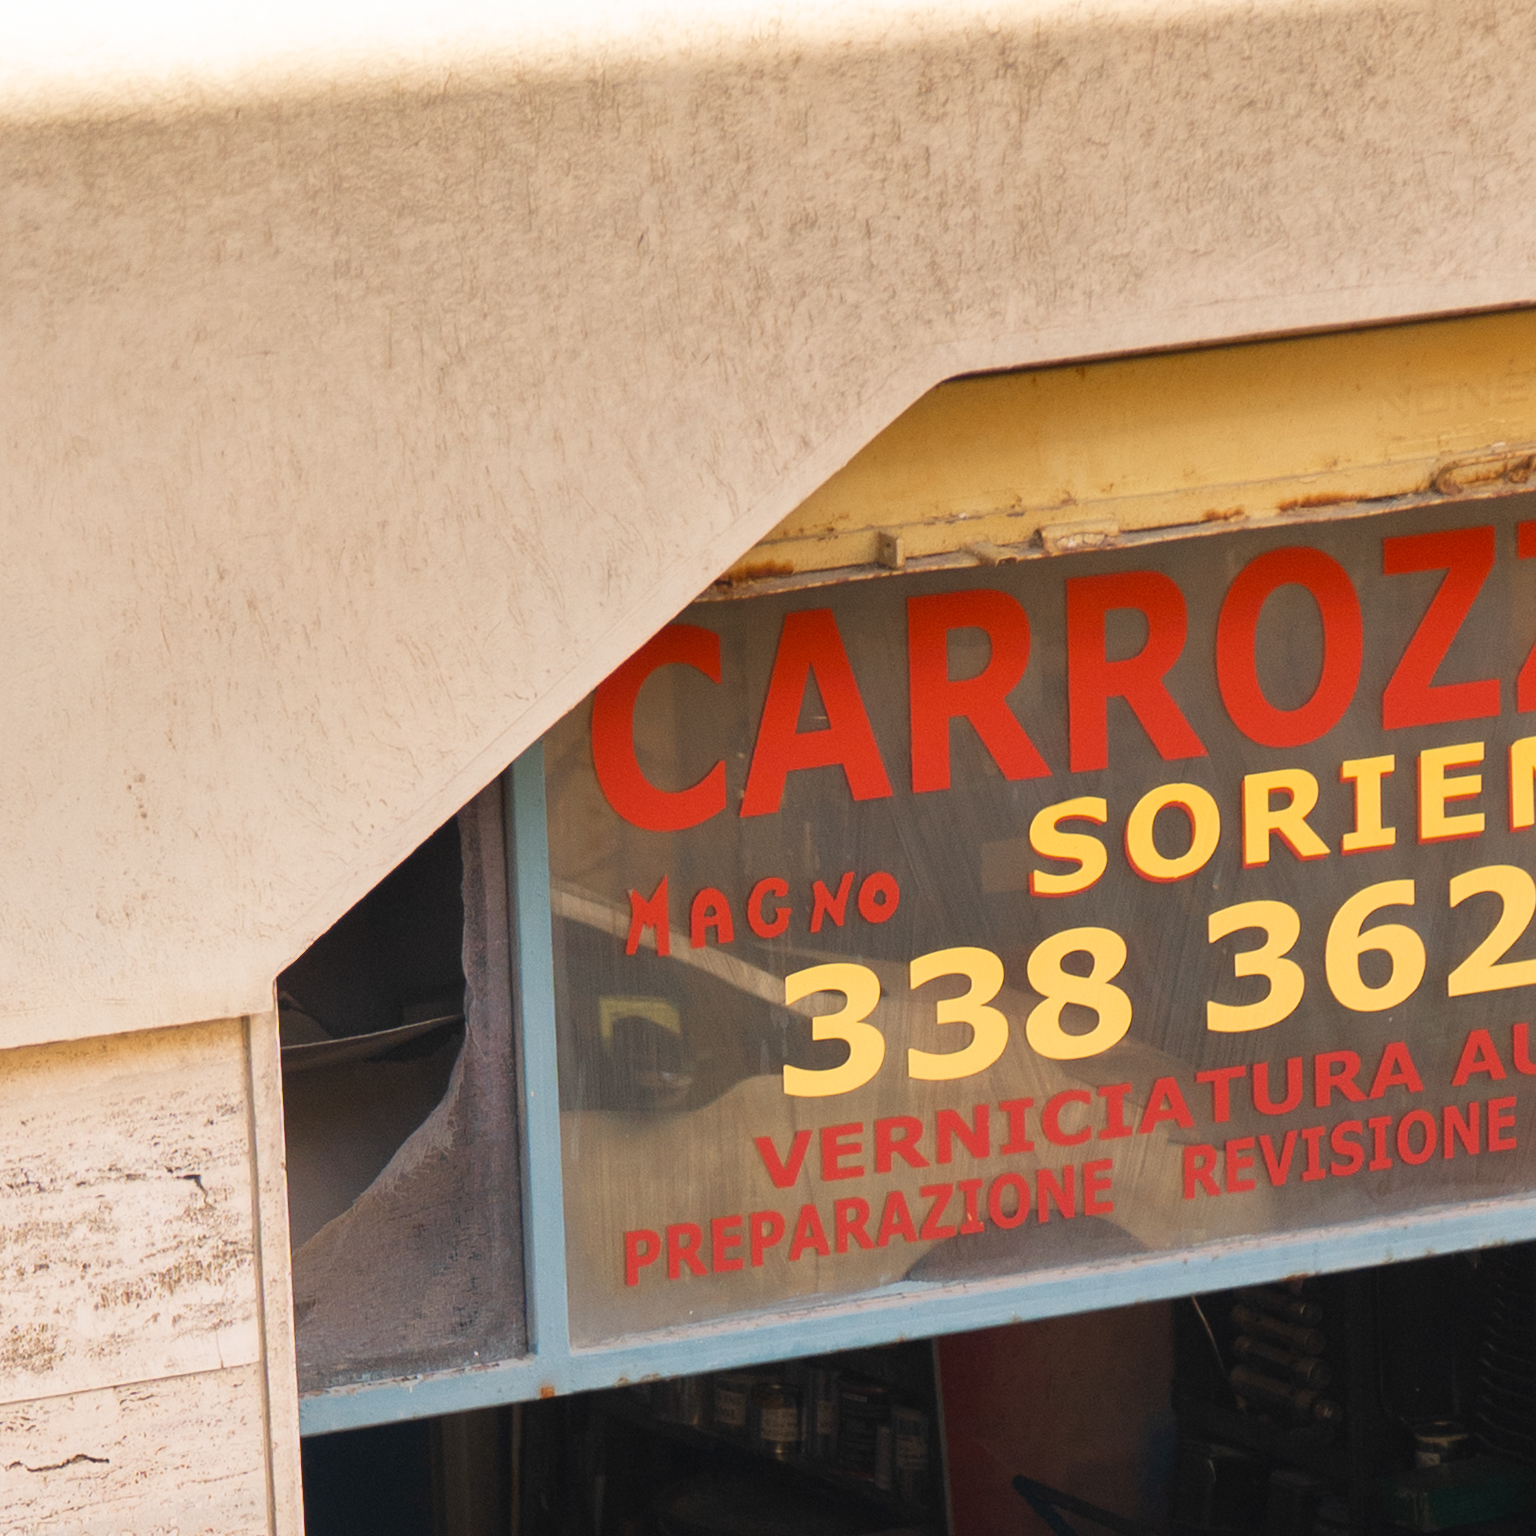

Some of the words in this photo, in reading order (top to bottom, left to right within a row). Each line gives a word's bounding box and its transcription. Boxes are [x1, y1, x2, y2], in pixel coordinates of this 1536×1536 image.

[625, 871, 901, 957] MAGNO
[783, 926, 1133, 1097] 338
[623, 1158, 1115, 1287] PREPARAZIONE
[1183, 1094, 1518, 1199] REVISIONE
[754, 1040, 1424, 1190] VERNICIATURA
